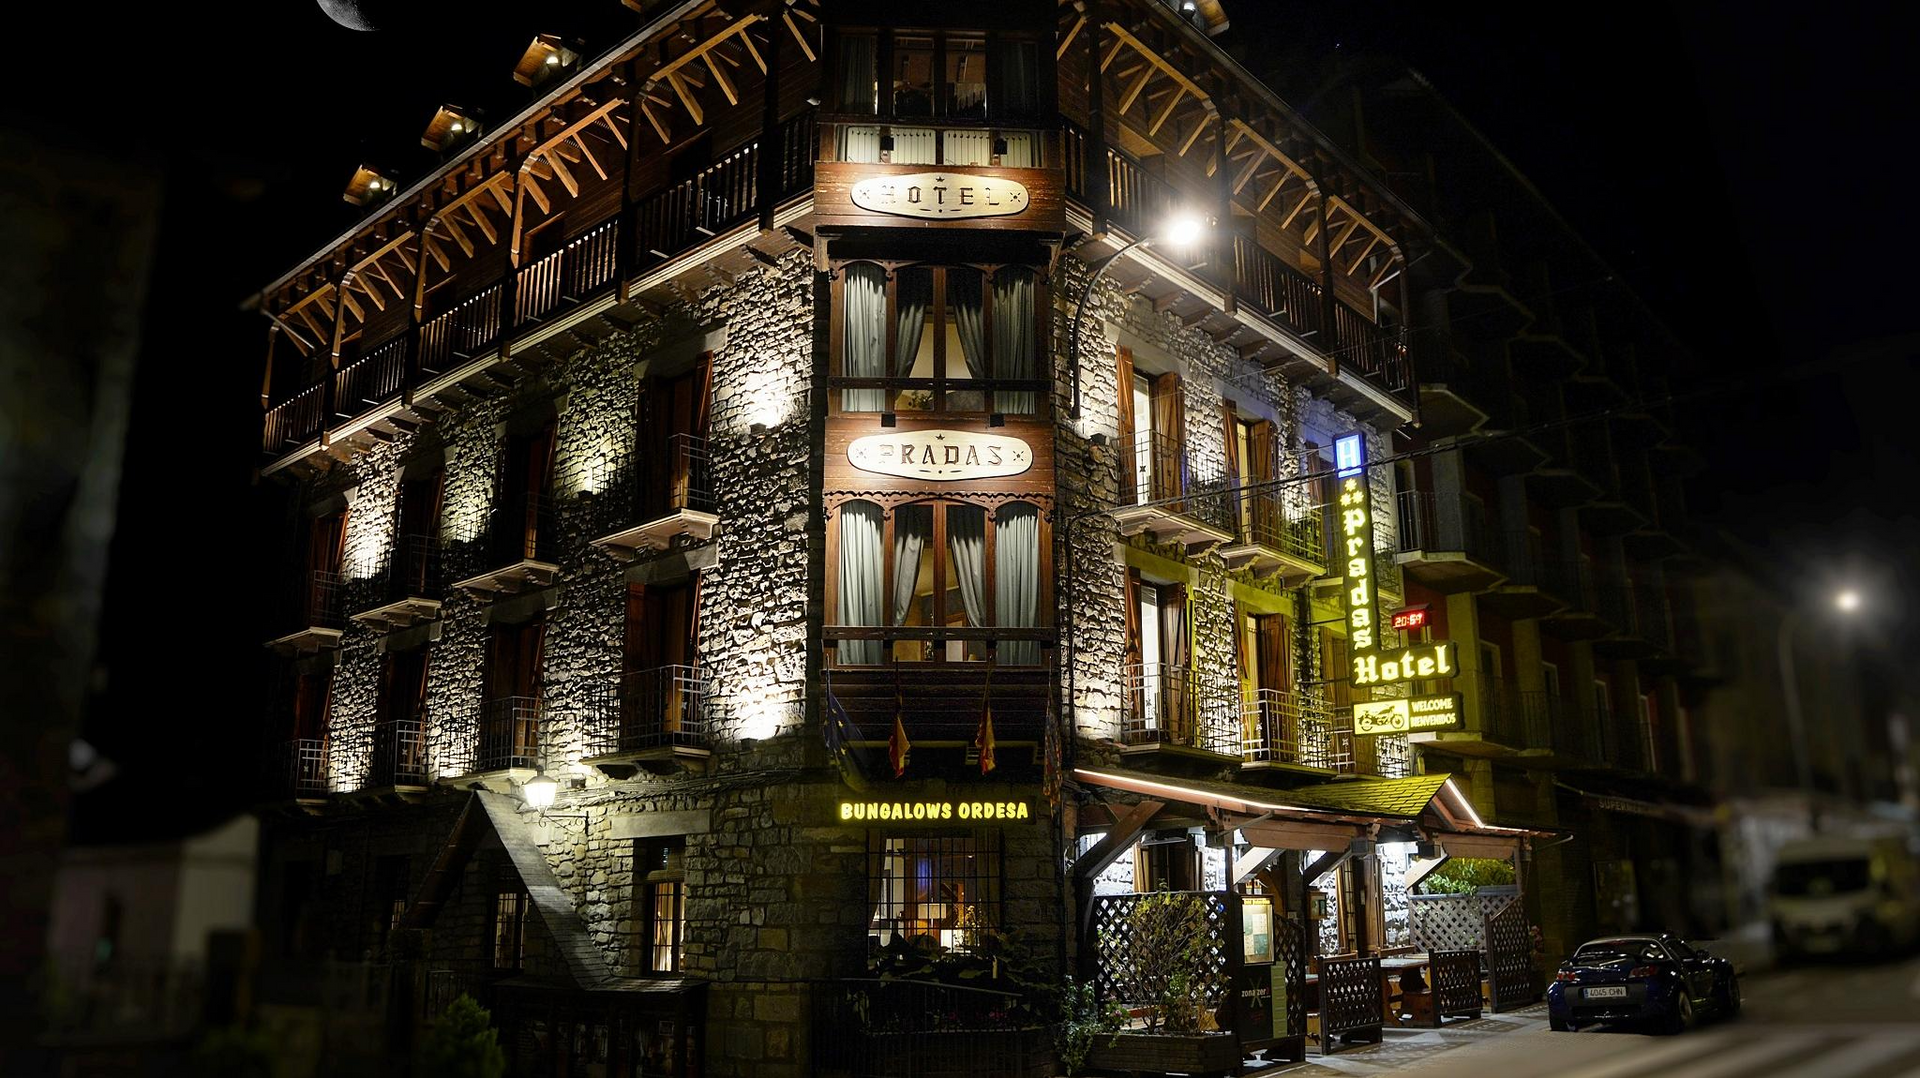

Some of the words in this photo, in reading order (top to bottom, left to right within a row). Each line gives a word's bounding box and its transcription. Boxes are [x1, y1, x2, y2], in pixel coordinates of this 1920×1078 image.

[879, 444, 1003, 466] PRADAS
[1353, 644, 1450, 685] Hotel
[1411, 697, 1453, 713] WELCOME
[1410, 713, 1456, 728] BIENVENIDOS
[841, 802, 952, 820] BUNGALOWS
[958, 802, 1029, 820] ORDESA
